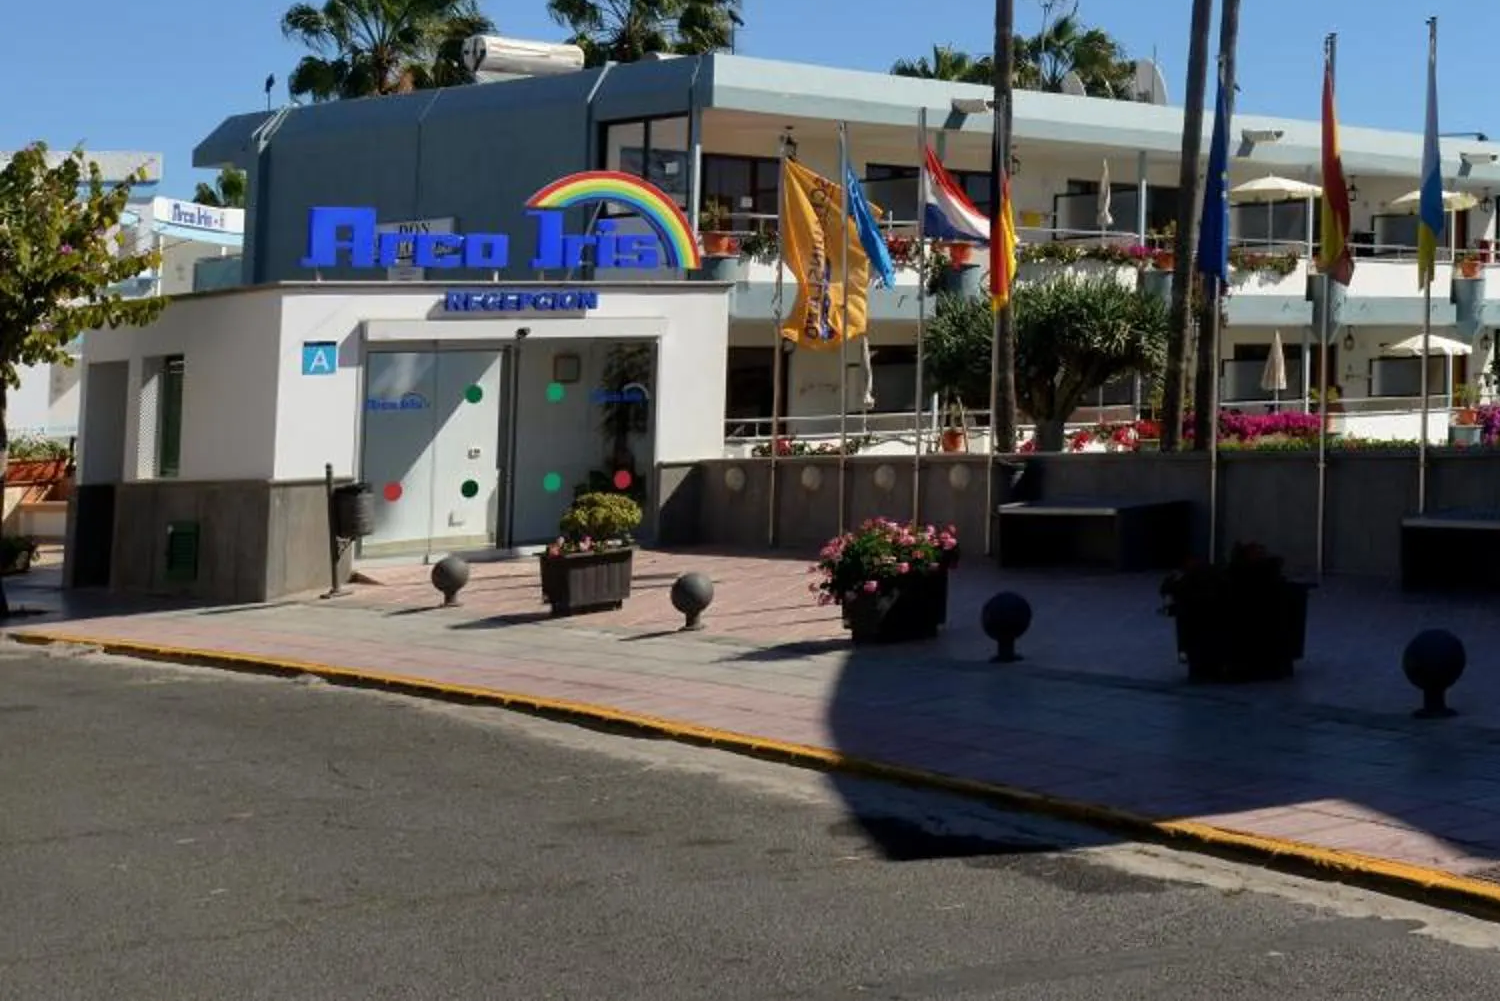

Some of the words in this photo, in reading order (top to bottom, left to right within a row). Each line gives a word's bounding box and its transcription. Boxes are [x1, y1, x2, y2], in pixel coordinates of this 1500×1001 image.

[302, 206, 510, 269] Arco
[526, 210, 662, 269] Iris
[309, 348, 329, 371] A
